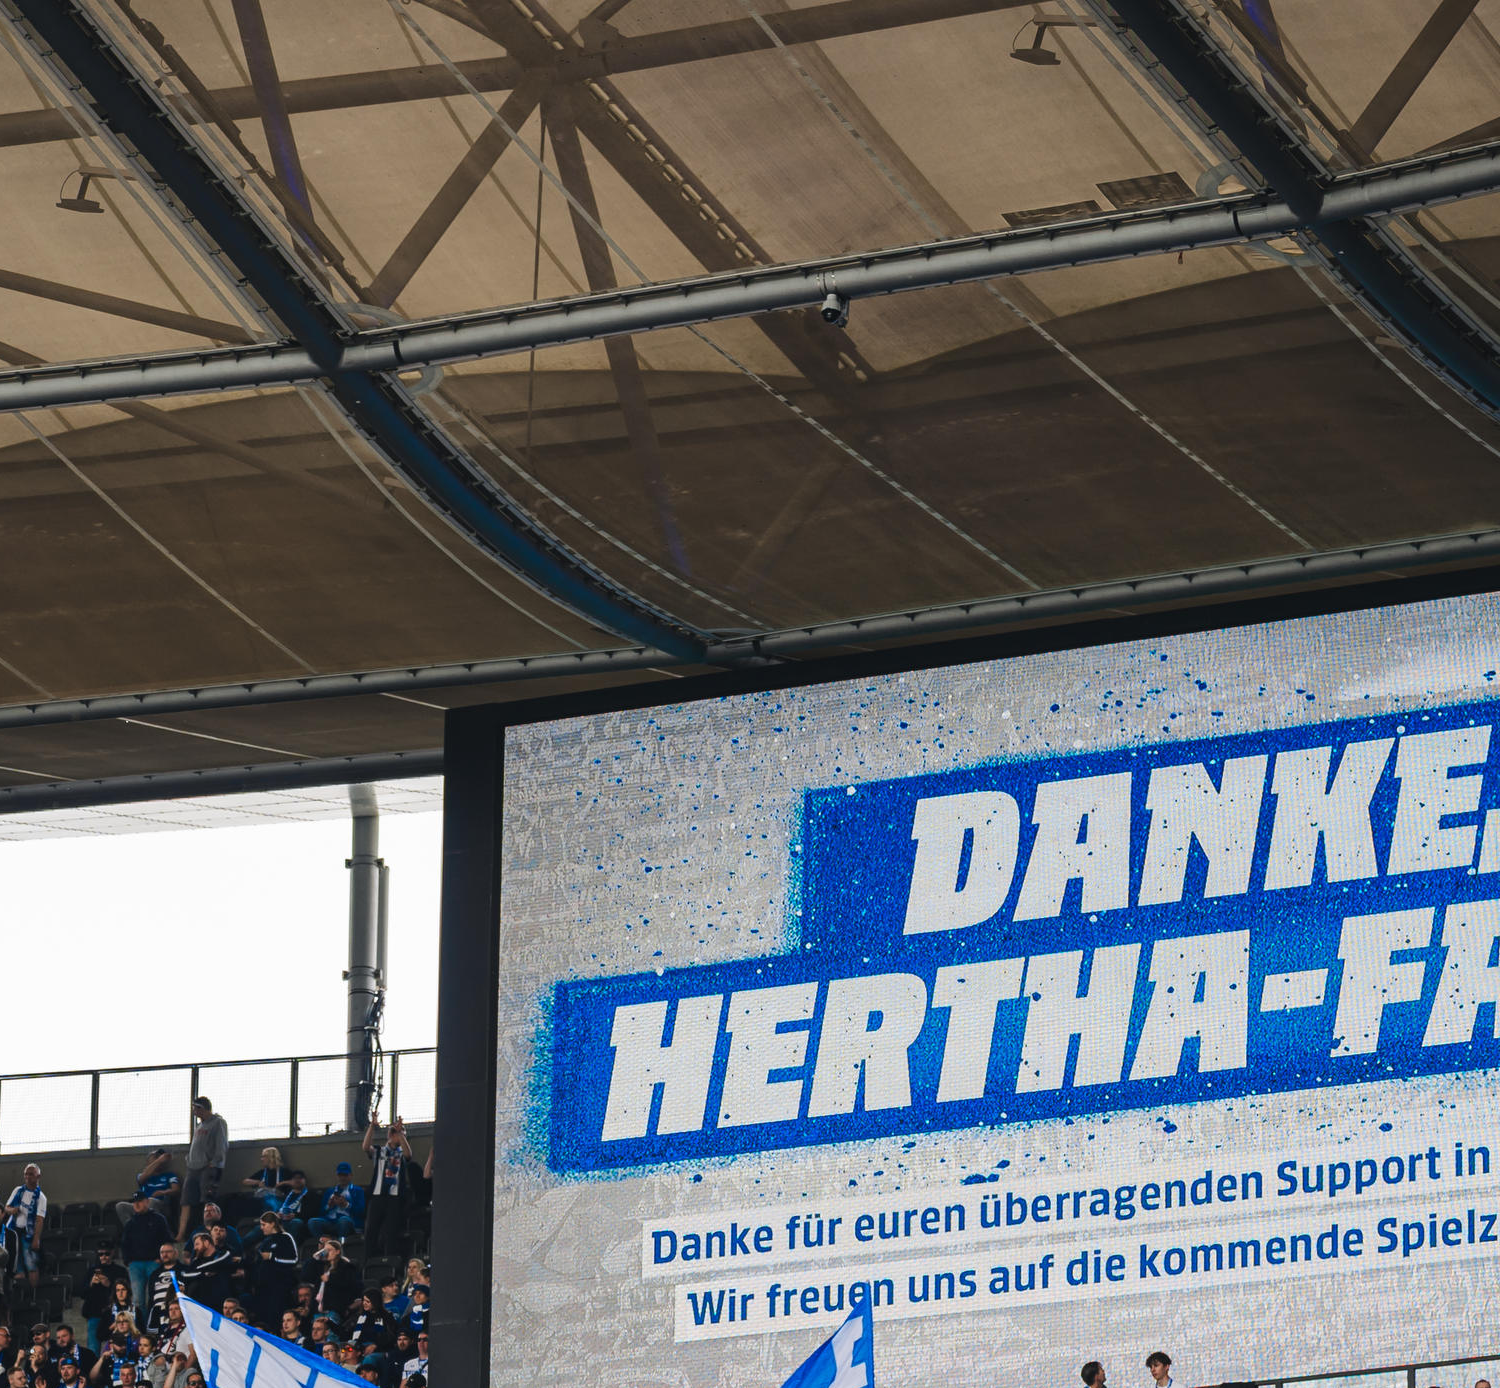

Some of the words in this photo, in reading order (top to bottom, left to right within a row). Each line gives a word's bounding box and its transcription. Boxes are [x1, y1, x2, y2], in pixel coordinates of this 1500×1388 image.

[651, 1223, 774, 1264] Danke
[786, 1216, 843, 1250] für
[854, 1204, 966, 1242] euren
[979, 1170, 1263, 1229] überragenden
[1276, 1146, 1442, 1197] Support
[1454, 1142, 1491, 1176] in
[686, 1286, 755, 1326] Wir
[765, 1275, 893, 1318] freuen
[908, 1268, 977, 1304] uns
[988, 1254, 1055, 1294] auf
[1065, 1247, 1126, 1287] die
[1139, 1223, 1364, 1279] kommende
